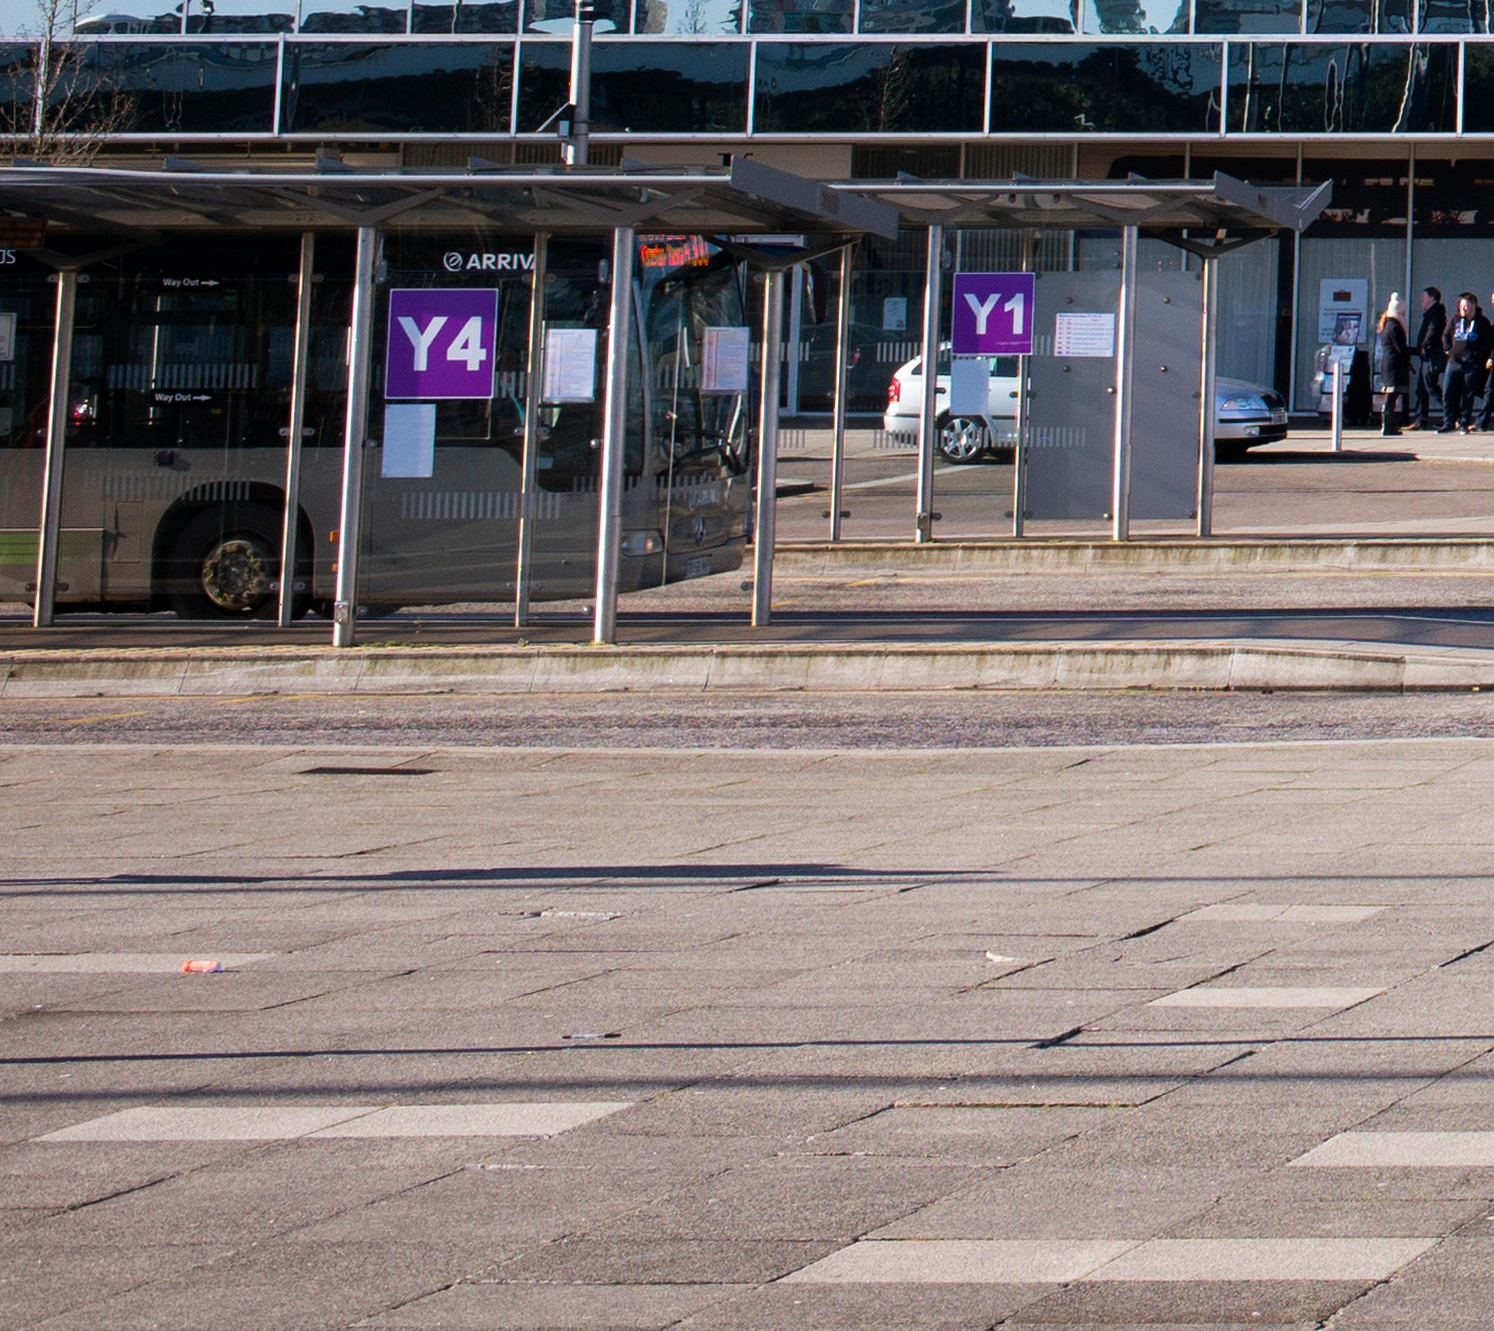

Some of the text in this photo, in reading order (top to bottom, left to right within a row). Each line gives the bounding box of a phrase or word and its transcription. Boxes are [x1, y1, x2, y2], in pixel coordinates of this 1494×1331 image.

[466, 253, 535, 270] ARRIV
[163, 278, 199, 287] Way Out
[963, 293, 1025, 335] Y1
[397, 316, 487, 372] Y4
[155, 393, 192, 402] Way Out
